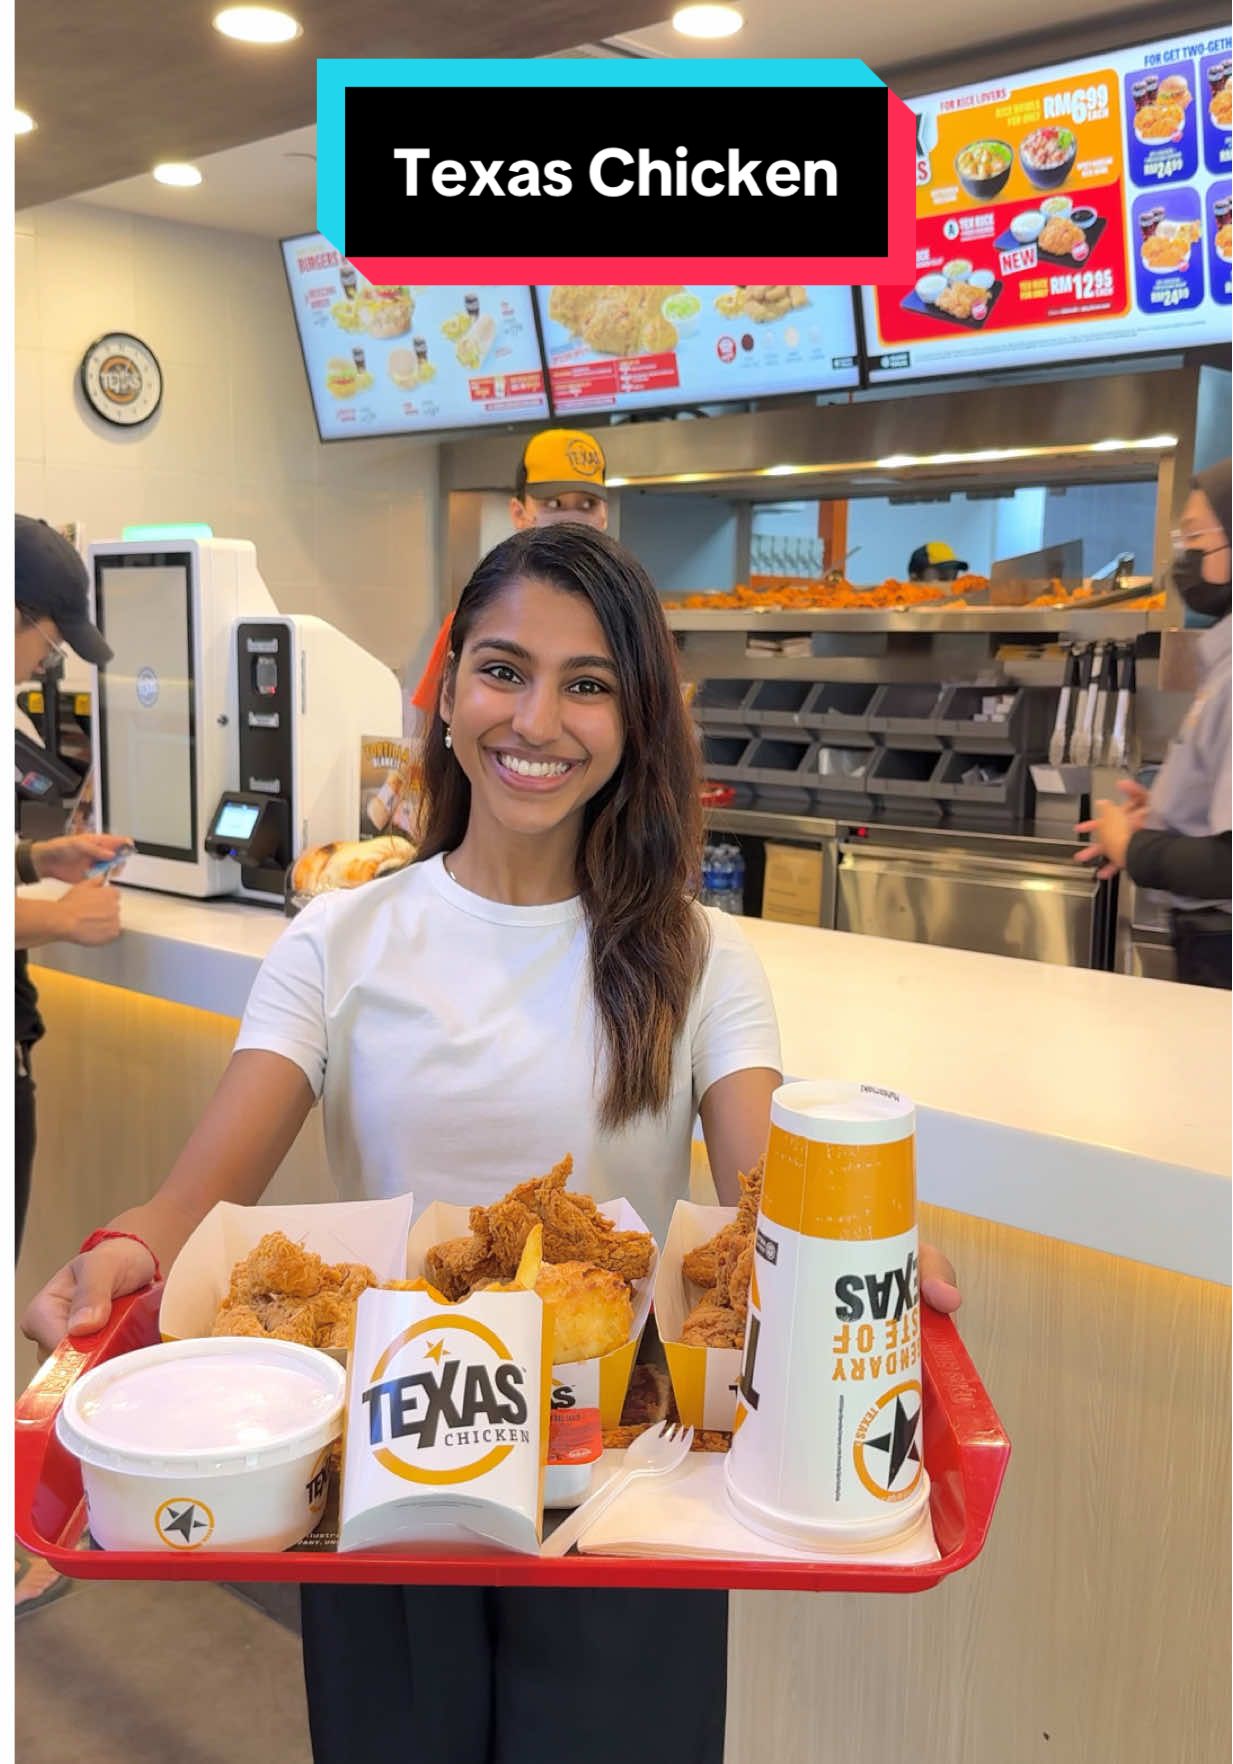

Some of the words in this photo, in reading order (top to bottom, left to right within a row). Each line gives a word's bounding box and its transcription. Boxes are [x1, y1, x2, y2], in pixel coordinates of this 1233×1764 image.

[1144, 55, 1161, 66] FOR
[1163, 49, 1180, 60] GET
[1002, 252, 1036, 272] NEW
[832, 1323, 874, 1354] OF
[362, 1360, 528, 1449] TEXAS
[444, 1430, 530, 1447] CHICKEN
[854, 1405, 879, 1450] TEXAS
